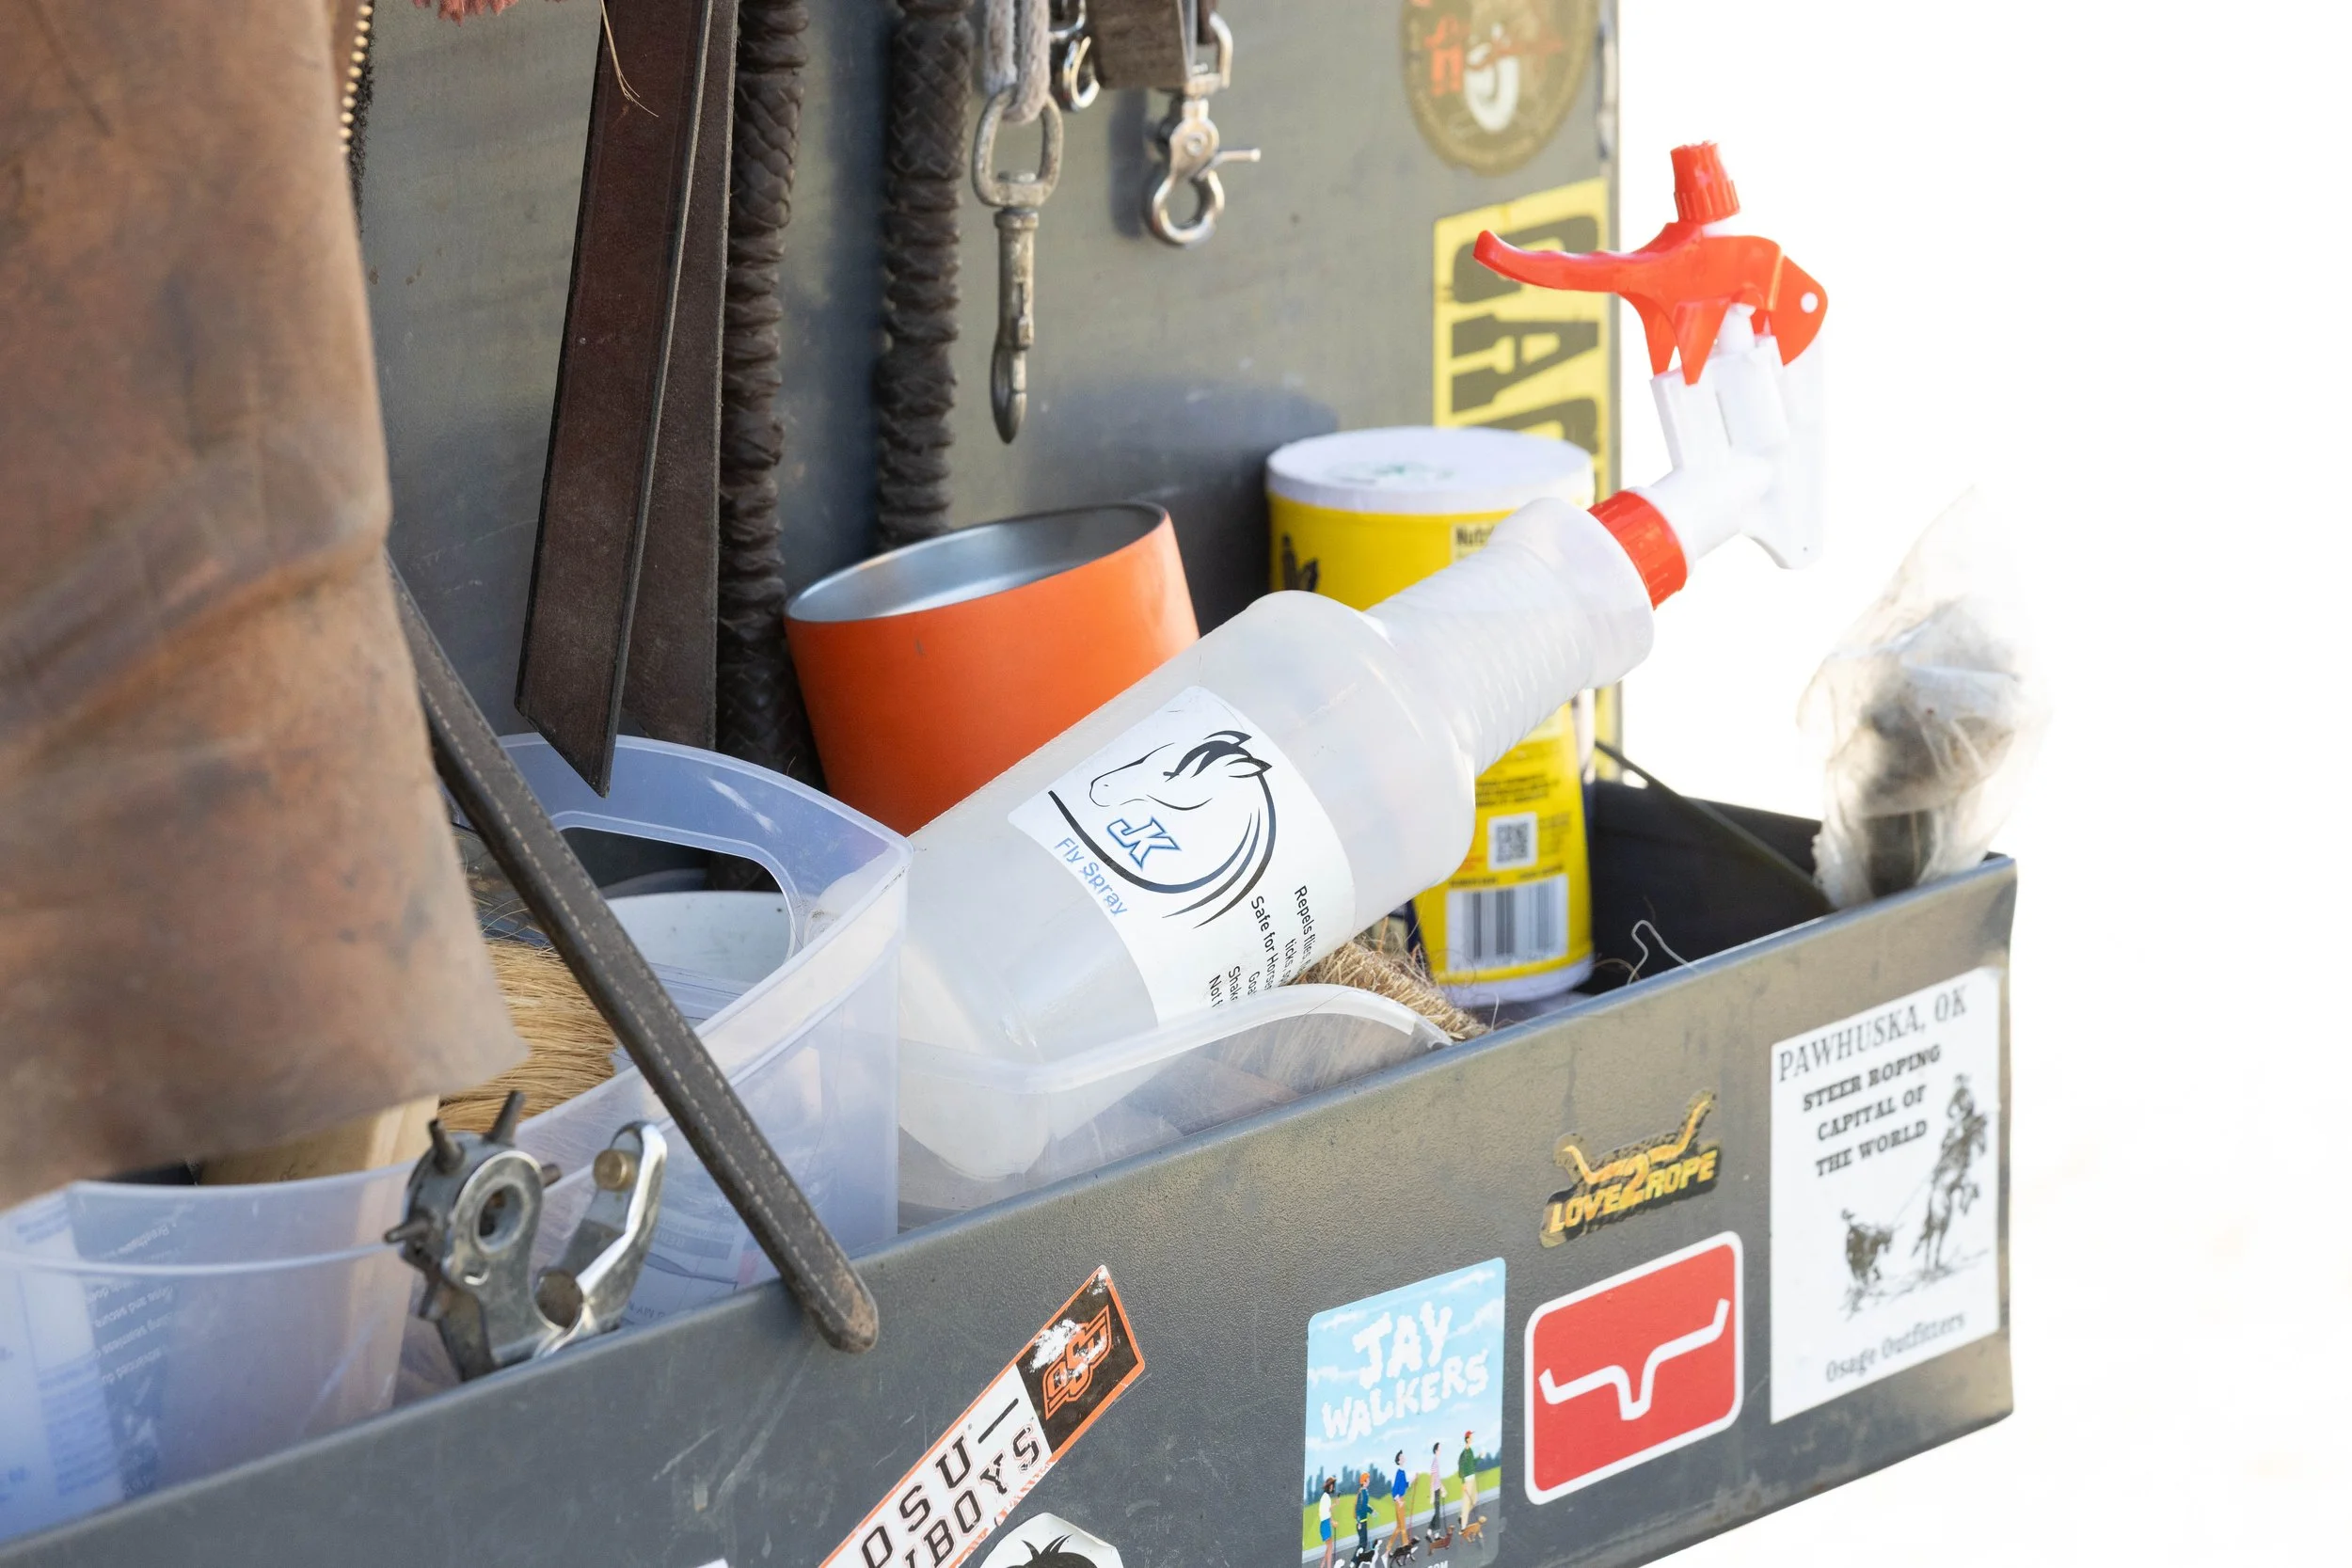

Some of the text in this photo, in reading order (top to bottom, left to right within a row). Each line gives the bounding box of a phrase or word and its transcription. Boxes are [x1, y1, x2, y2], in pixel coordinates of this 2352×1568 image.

[1106, 816, 1182, 871] JK
[1054, 836, 1128, 916] Fly Spray
[1251, 895, 1271, 932] Safe
[1263, 931, 1276, 953] for
[1295, 885, 1315, 935] Repels
[1209, 974, 1223, 1002] Not
[1779, 984, 1967, 1082] PAWHUSKA, OK
[1804, 1043, 1941, 1112] STEER ROPING
[1818, 1085, 1927, 1141] CAPITAL OF
[1816, 1119, 1927, 1177] THE WORLD
[1352, 1301, 1454, 1390] JAY
[1826, 1313, 1965, 1383] Osage Outfitters
[1321, 1349, 1489, 1442] WALKERS
